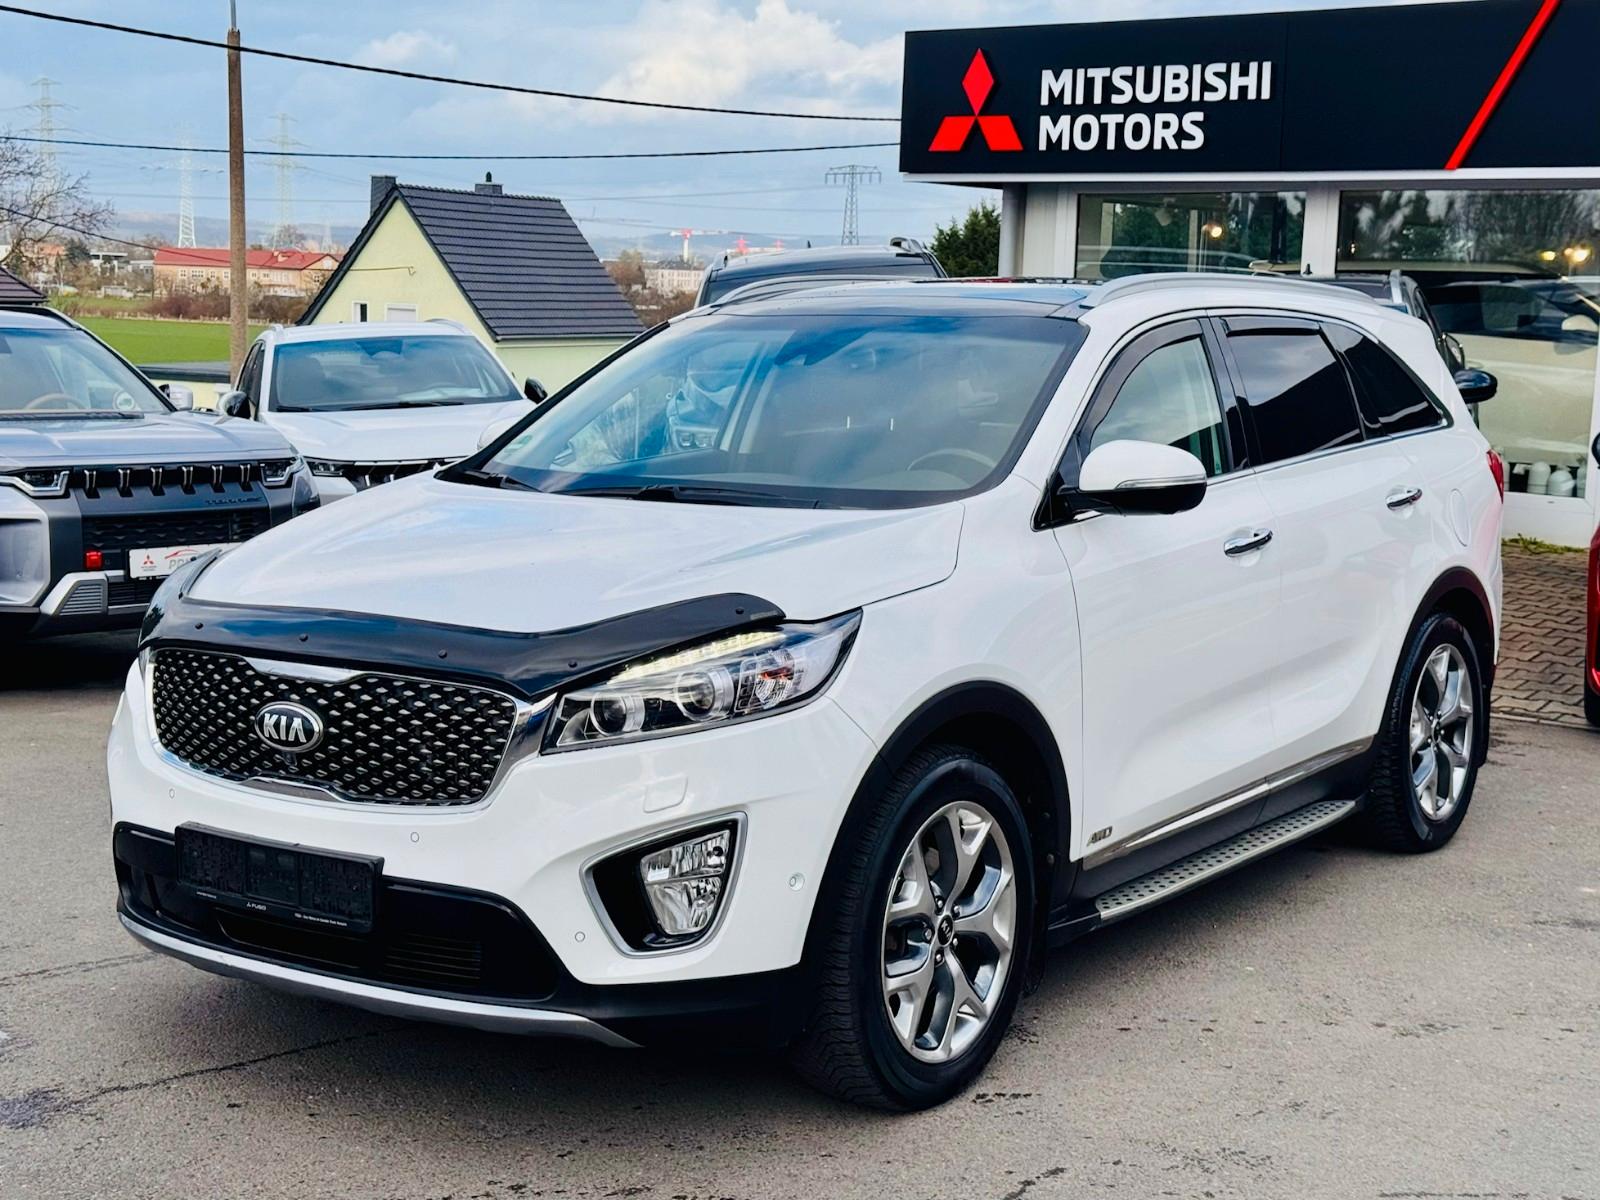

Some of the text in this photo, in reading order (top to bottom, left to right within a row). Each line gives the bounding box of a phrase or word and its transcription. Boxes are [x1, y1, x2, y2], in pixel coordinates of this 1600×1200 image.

[1040, 61, 1272, 106] MITSUBISHI
[1038, 111, 1205, 151] MOTORS
[263, 712, 307, 743] KIA
